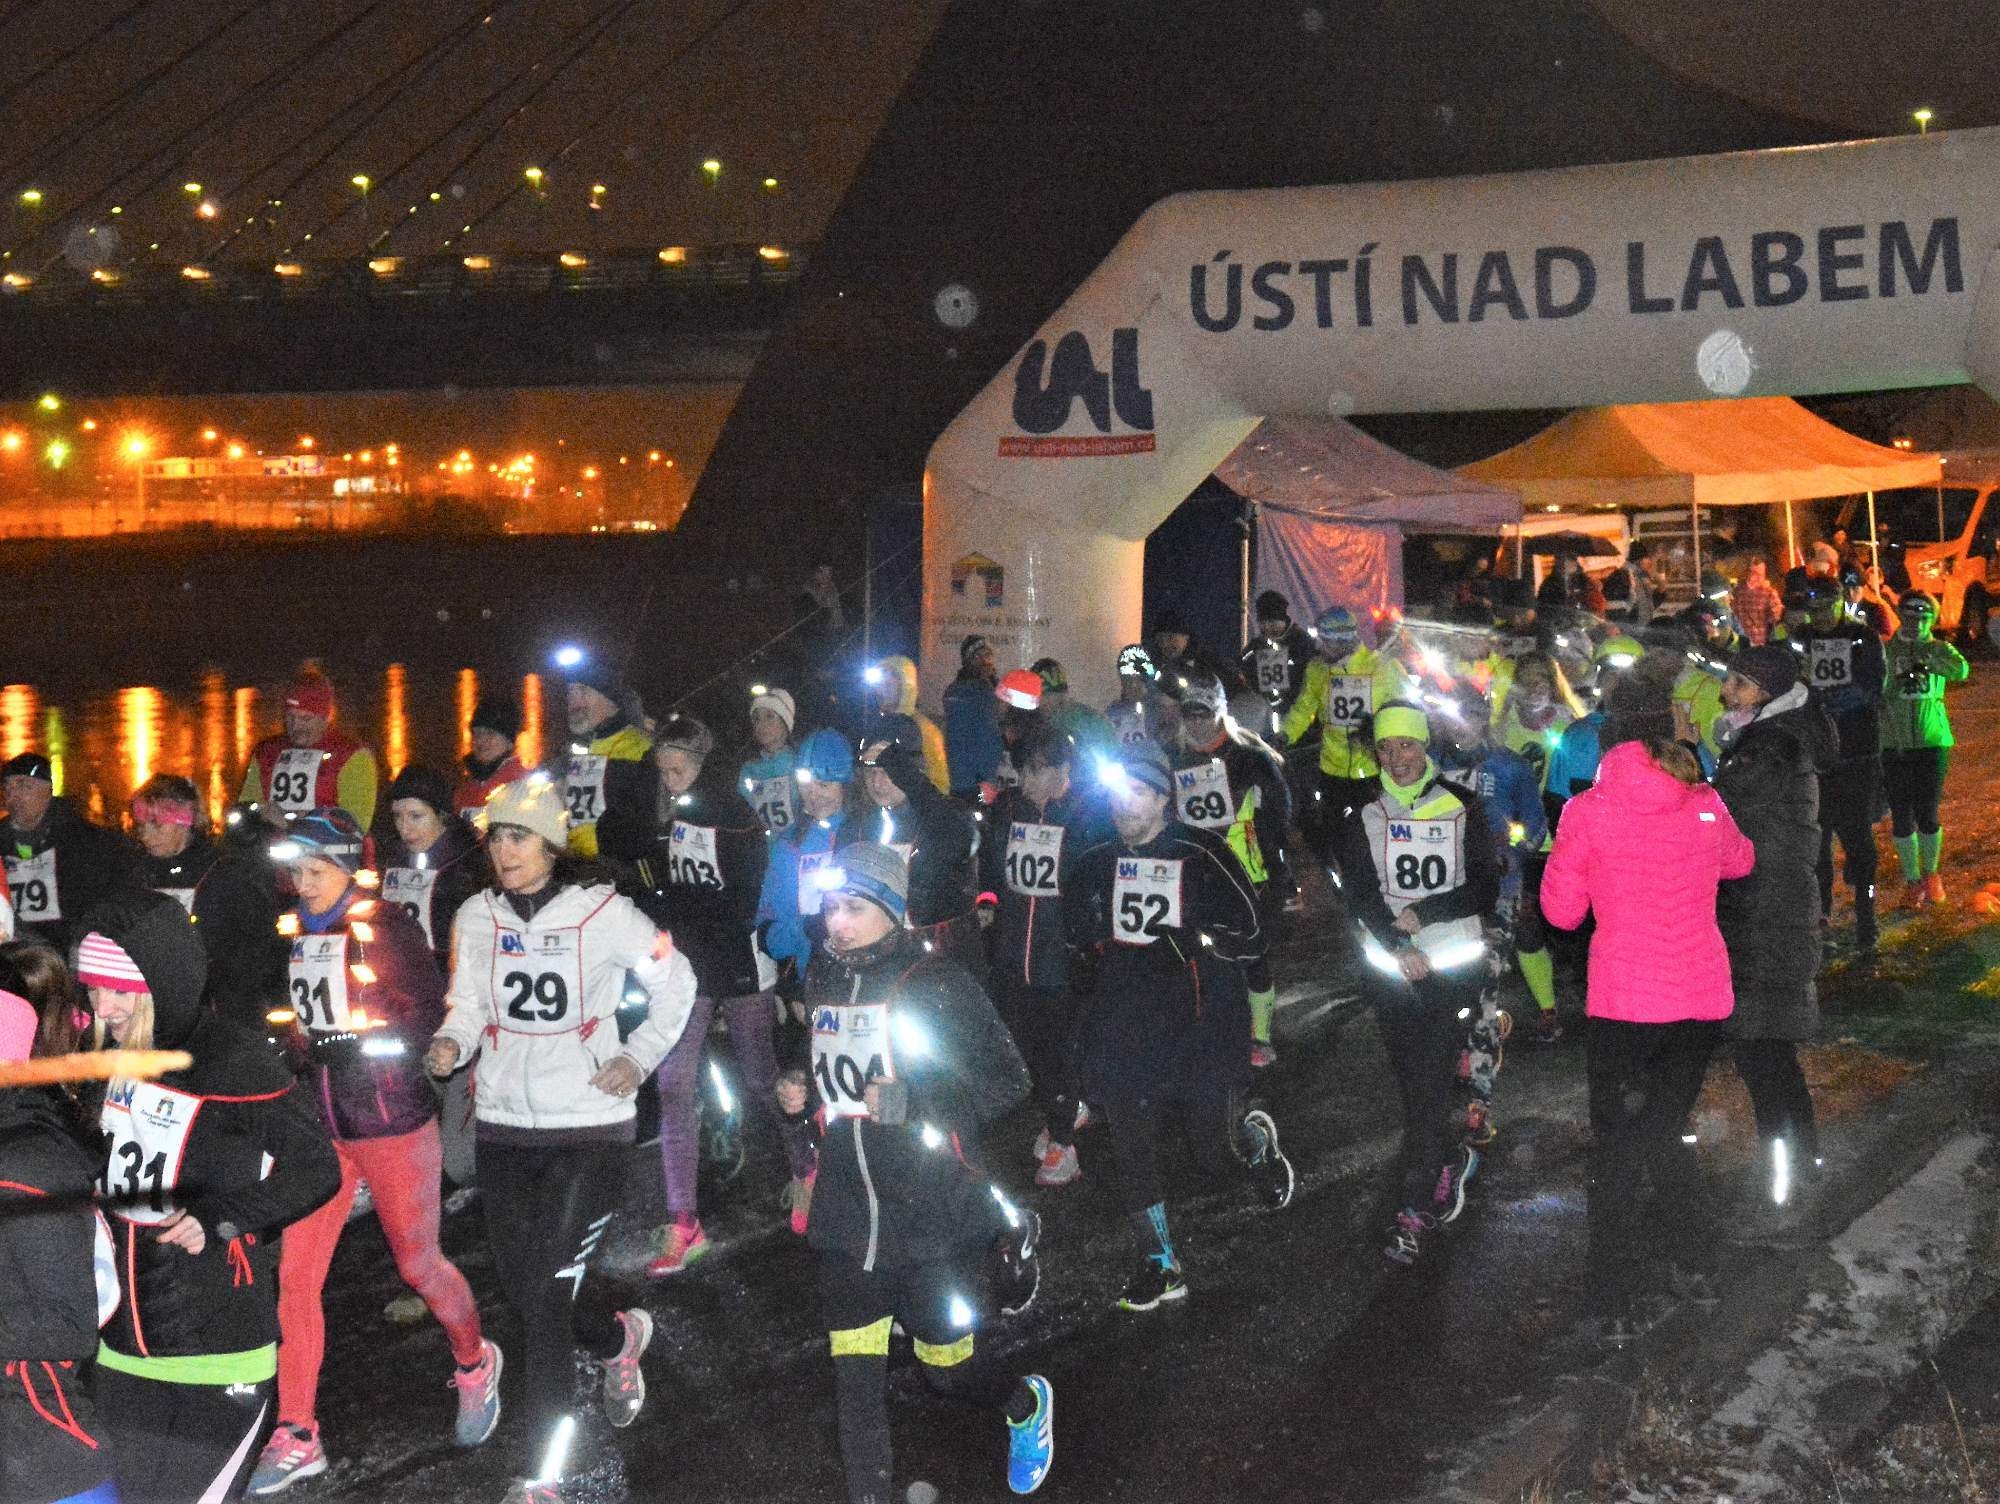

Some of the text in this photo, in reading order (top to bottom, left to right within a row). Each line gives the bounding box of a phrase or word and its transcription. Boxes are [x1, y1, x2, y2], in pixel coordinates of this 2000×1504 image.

[1190, 217, 1964, 332] ÚSTÍ NAD LABEM
[1261, 662, 1285, 687] 58
[1815, 657, 1846, 681] 68
[1333, 696, 1366, 720] 82
[272, 771, 309, 804] 93
[566, 785, 597, 820] 27
[1185, 790, 1227, 822] 69
[670, 855, 722, 889] 103
[1006, 851, 1057, 889] 102
[1395, 853, 1447, 890] 80
[8, 878, 49, 912] 79
[1119, 891, 1171, 937] 52
[292, 975, 336, 1026] 31
[503, 970, 569, 1022] 29
